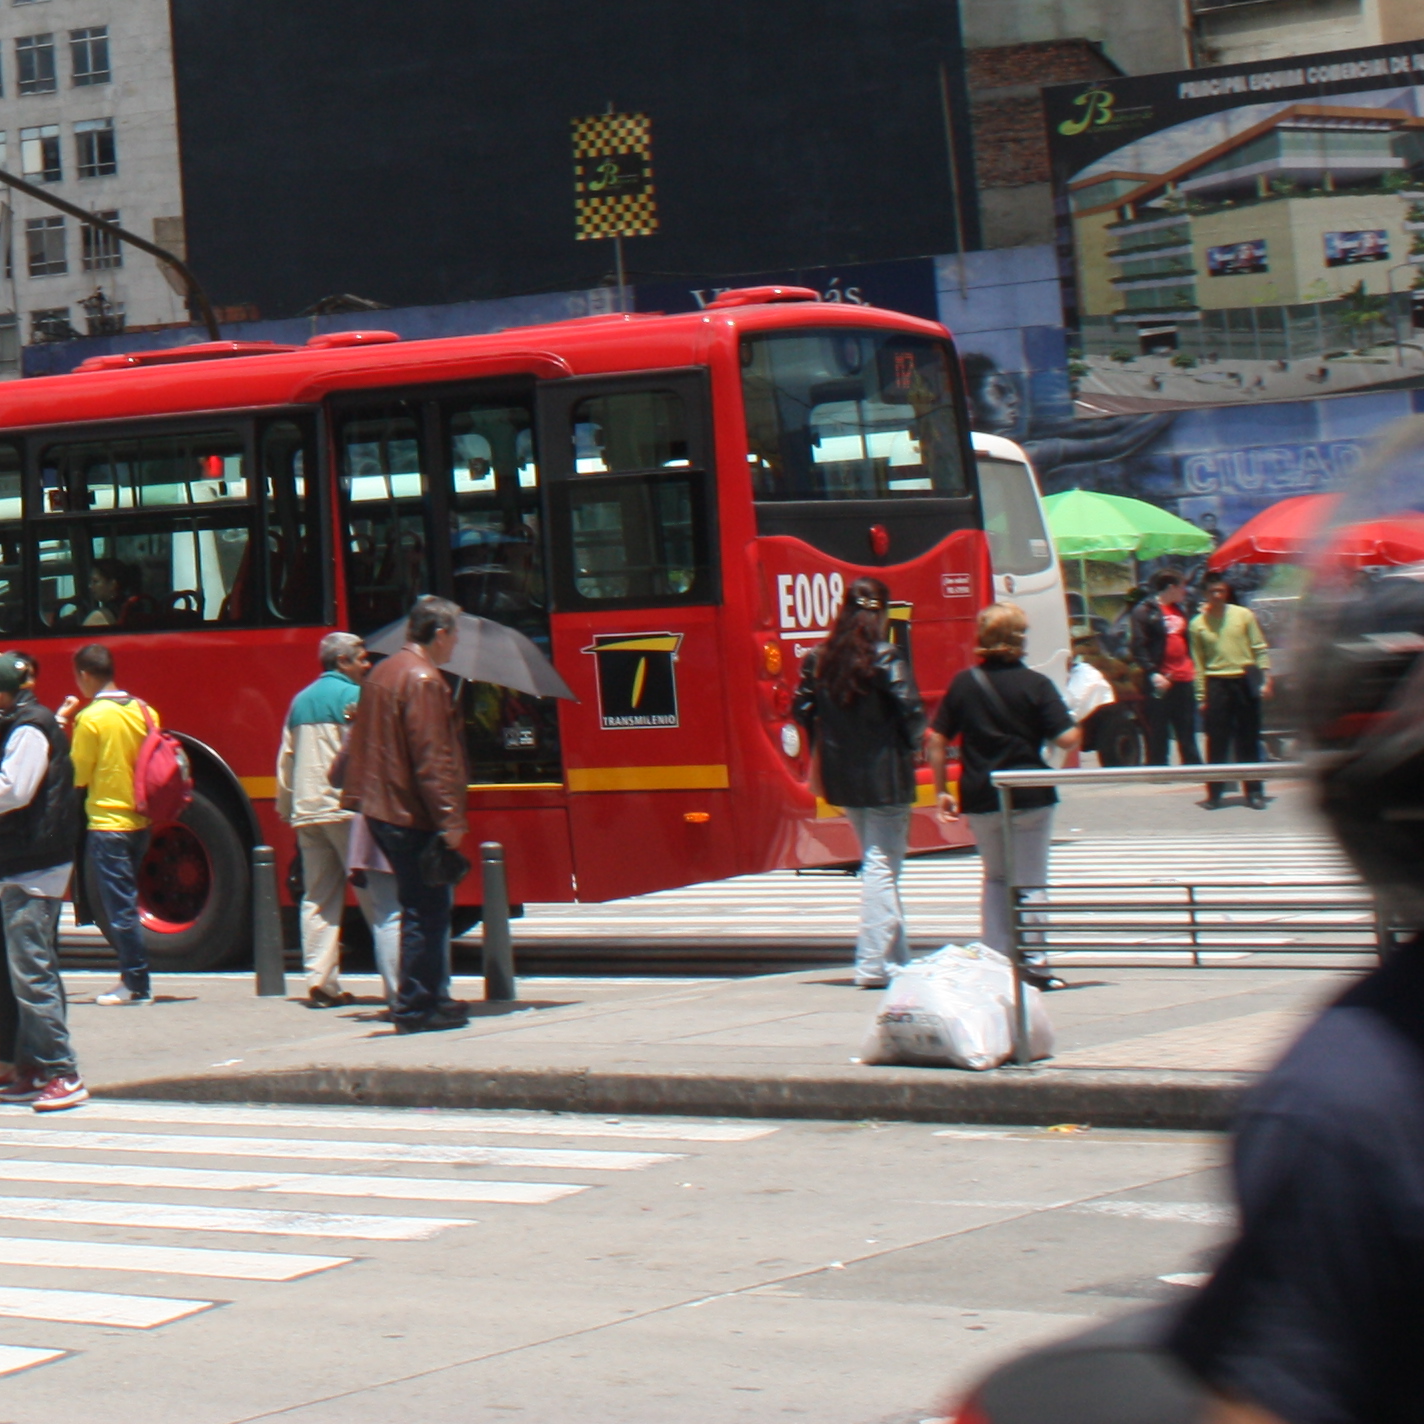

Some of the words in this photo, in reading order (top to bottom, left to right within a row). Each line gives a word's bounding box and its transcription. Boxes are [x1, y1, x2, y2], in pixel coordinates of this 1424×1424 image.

[1307, 58, 1389, 84] COMERCIAL
[1390, 55, 1410, 74] DE
[777, 572, 845, 628] E008
[602, 715, 677, 726] TRANSMILENIO
